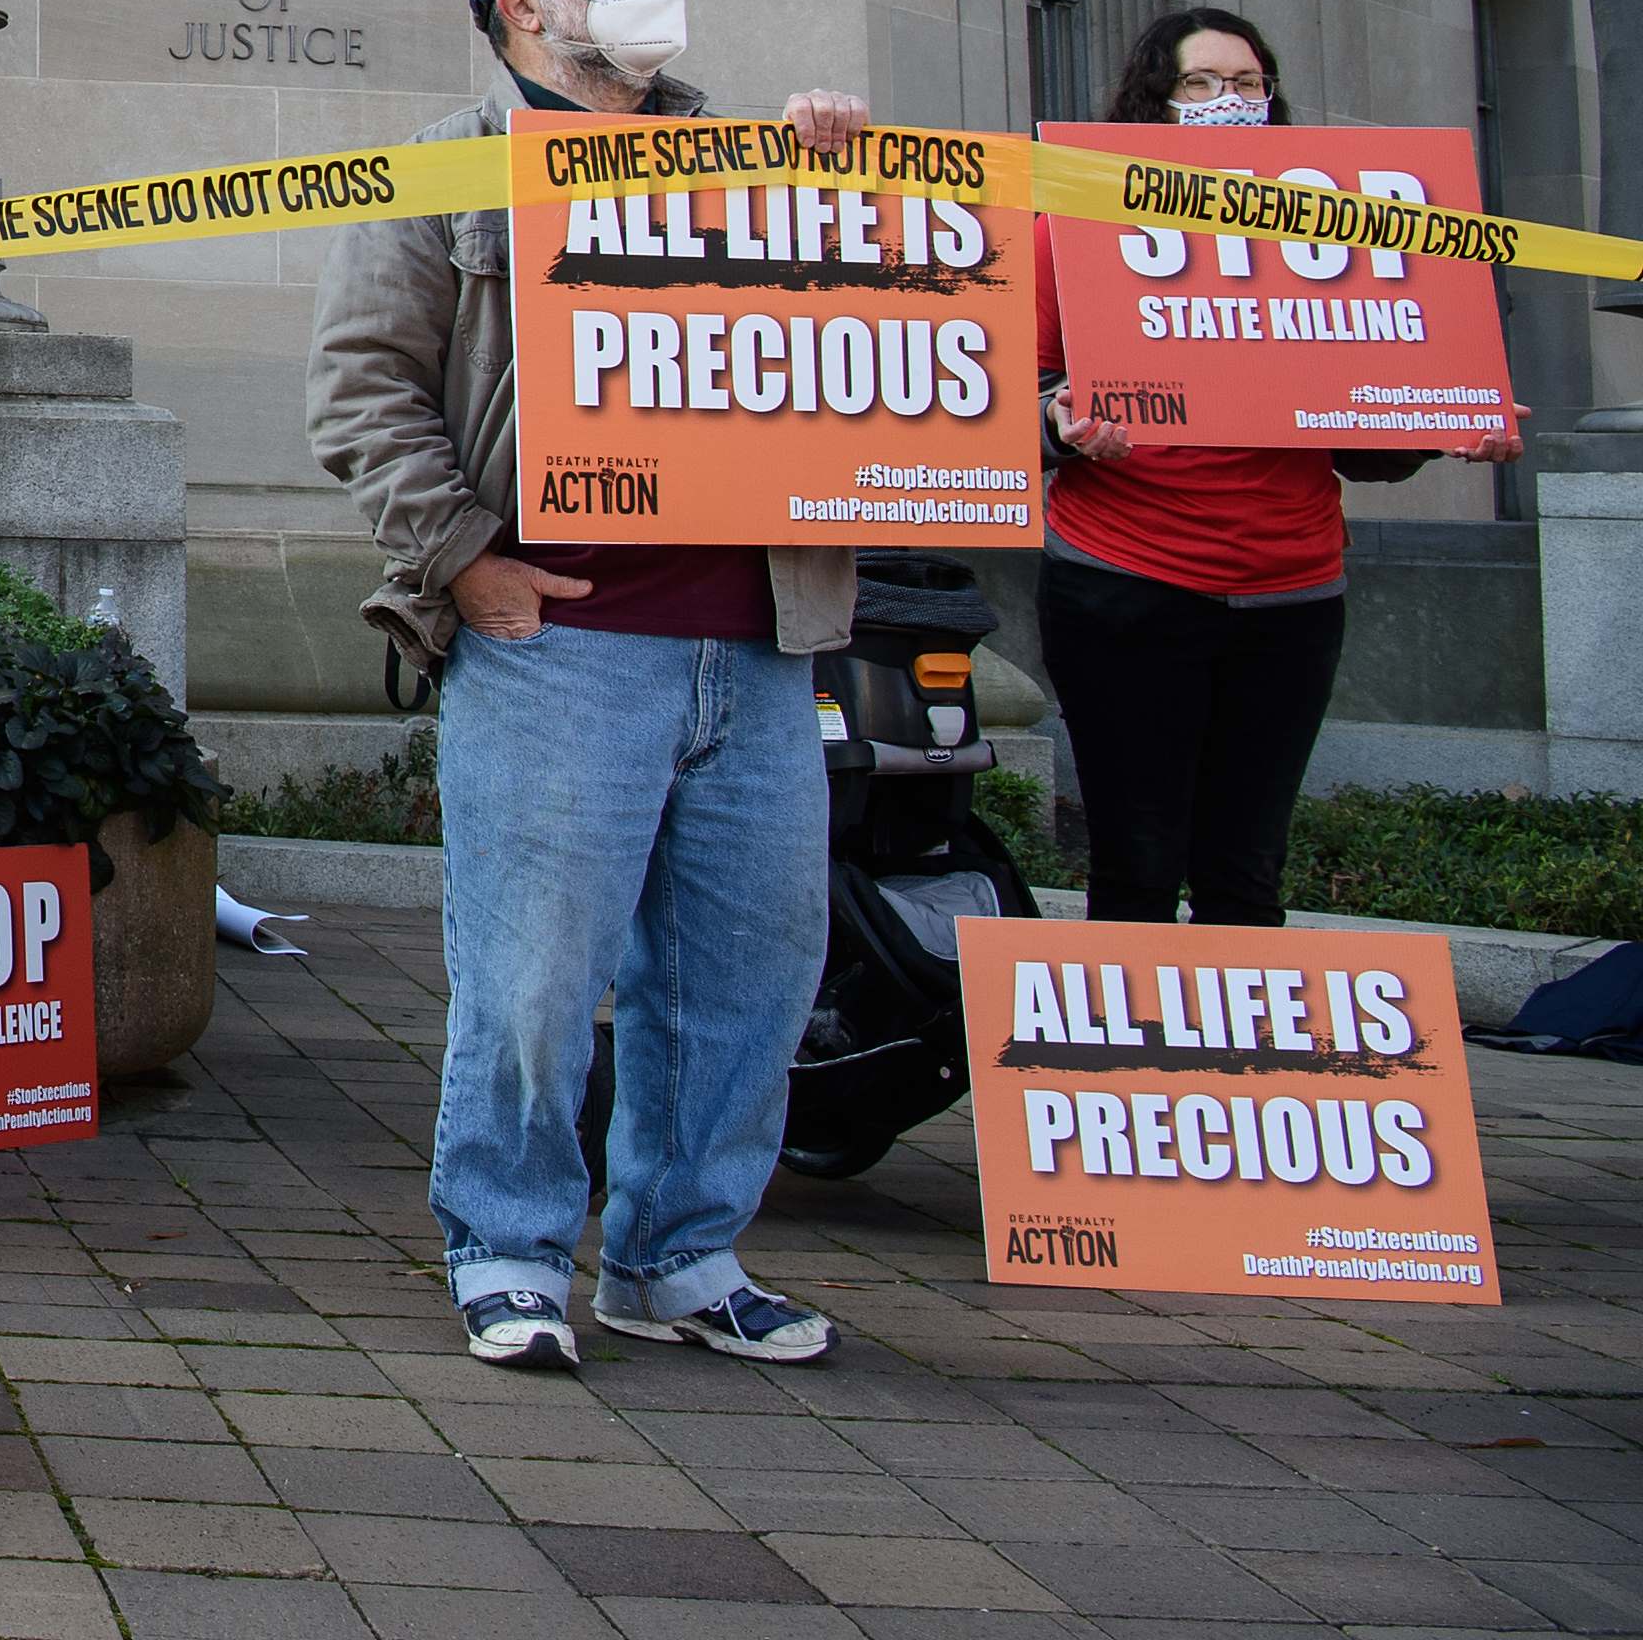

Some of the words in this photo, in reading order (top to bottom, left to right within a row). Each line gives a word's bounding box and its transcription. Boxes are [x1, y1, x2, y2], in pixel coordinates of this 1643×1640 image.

[168, 22, 365, 68] JUSTICE
[545, 132, 650, 187] CRIME
[651, 126, 758, 178] SCENE
[758, 124, 800, 170] DO
[878, 132, 984, 189] CROSS
[32, 185, 144, 235] SCENE
[147, 177, 197, 226] DO
[202, 168, 273, 221] NOT
[277, 155, 395, 211] CROSS
[1123, 163, 1217, 221] CRIME
[1220, 178, 1312, 237] SCENE
[1313, 194, 1357, 241] DO
[1358, 202, 1422, 251] NOT
[1421, 213, 1519, 265] CROSS
[566, 173, 705, 258] ALL
[725, 171, 881, 264] LIFE
[902, 181, 984, 269] IS
[1138, 295, 1263, 340] STATE
[1268, 297, 1426, 342] KILLING
[572, 309, 990, 418] PRECIOUS
[1091, 380, 1128, 389] DEATH
[1133, 381, 1184, 391] PENALTY
[1349, 384, 1501, 407] #StopExecutions
[1089, 389, 1187, 426] ACTION
[1295, 409, 1505, 432] DeathPenaltyAction.org
[546, 455, 591, 466] DEATH
[598, 457, 660, 469] PENALTY
[854, 463, 1028, 492] #StopExecutions
[539, 467, 659, 516] ACTION
[789, 495, 1029, 528] DeathPenaltyAction.org
[1013, 961, 1144, 1047] ALL
[1156, 966, 1313, 1051] LIFE
[1325, 970, 1413, 1055] IS
[7, 1081, 91, 1105] #StopExecutions
[1024, 1089, 1433, 1187] PRECIOUS
[1009, 1214, 1051, 1225] DEATH
[1057, 1215, 1116, 1227] PENALTY
[1007, 1226, 1118, 1268] ACTION
[1305, 1228, 1480, 1254] #StopExecutions
[1243, 1253, 1483, 1286] DeathPenaltyAction.org
